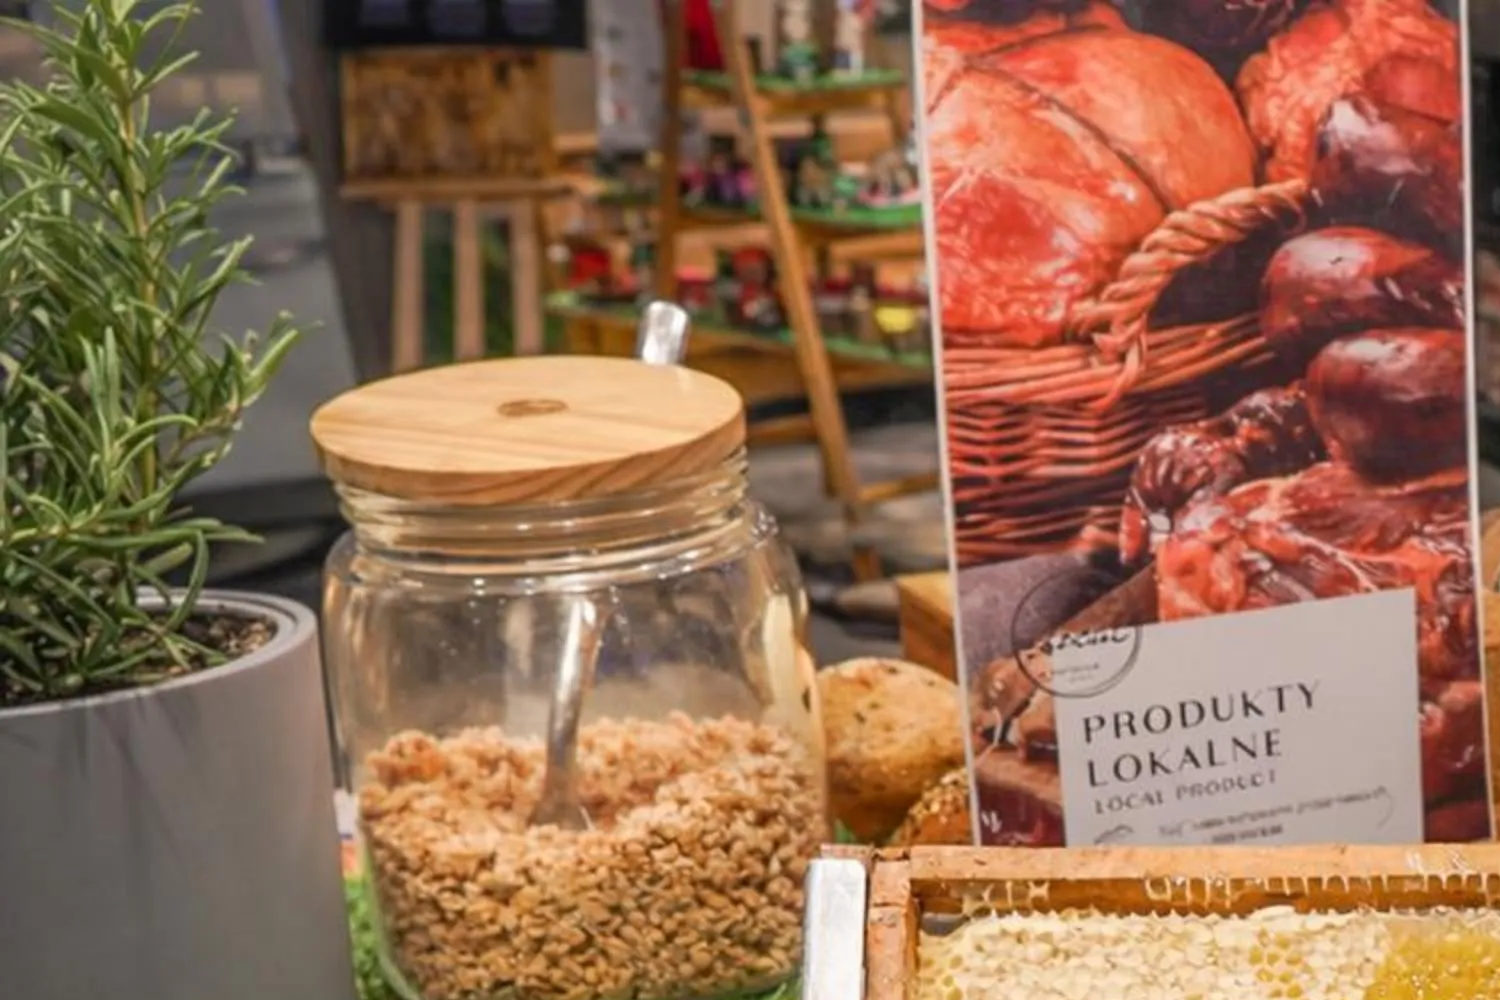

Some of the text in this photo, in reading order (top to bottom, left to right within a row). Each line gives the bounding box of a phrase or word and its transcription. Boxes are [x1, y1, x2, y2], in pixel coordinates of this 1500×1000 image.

[1083, 679, 1320, 744] PRODUKTY
[1087, 728, 1281, 788] LOKALNE
[1095, 769, 1276, 815] LOCAL PRODUCT
